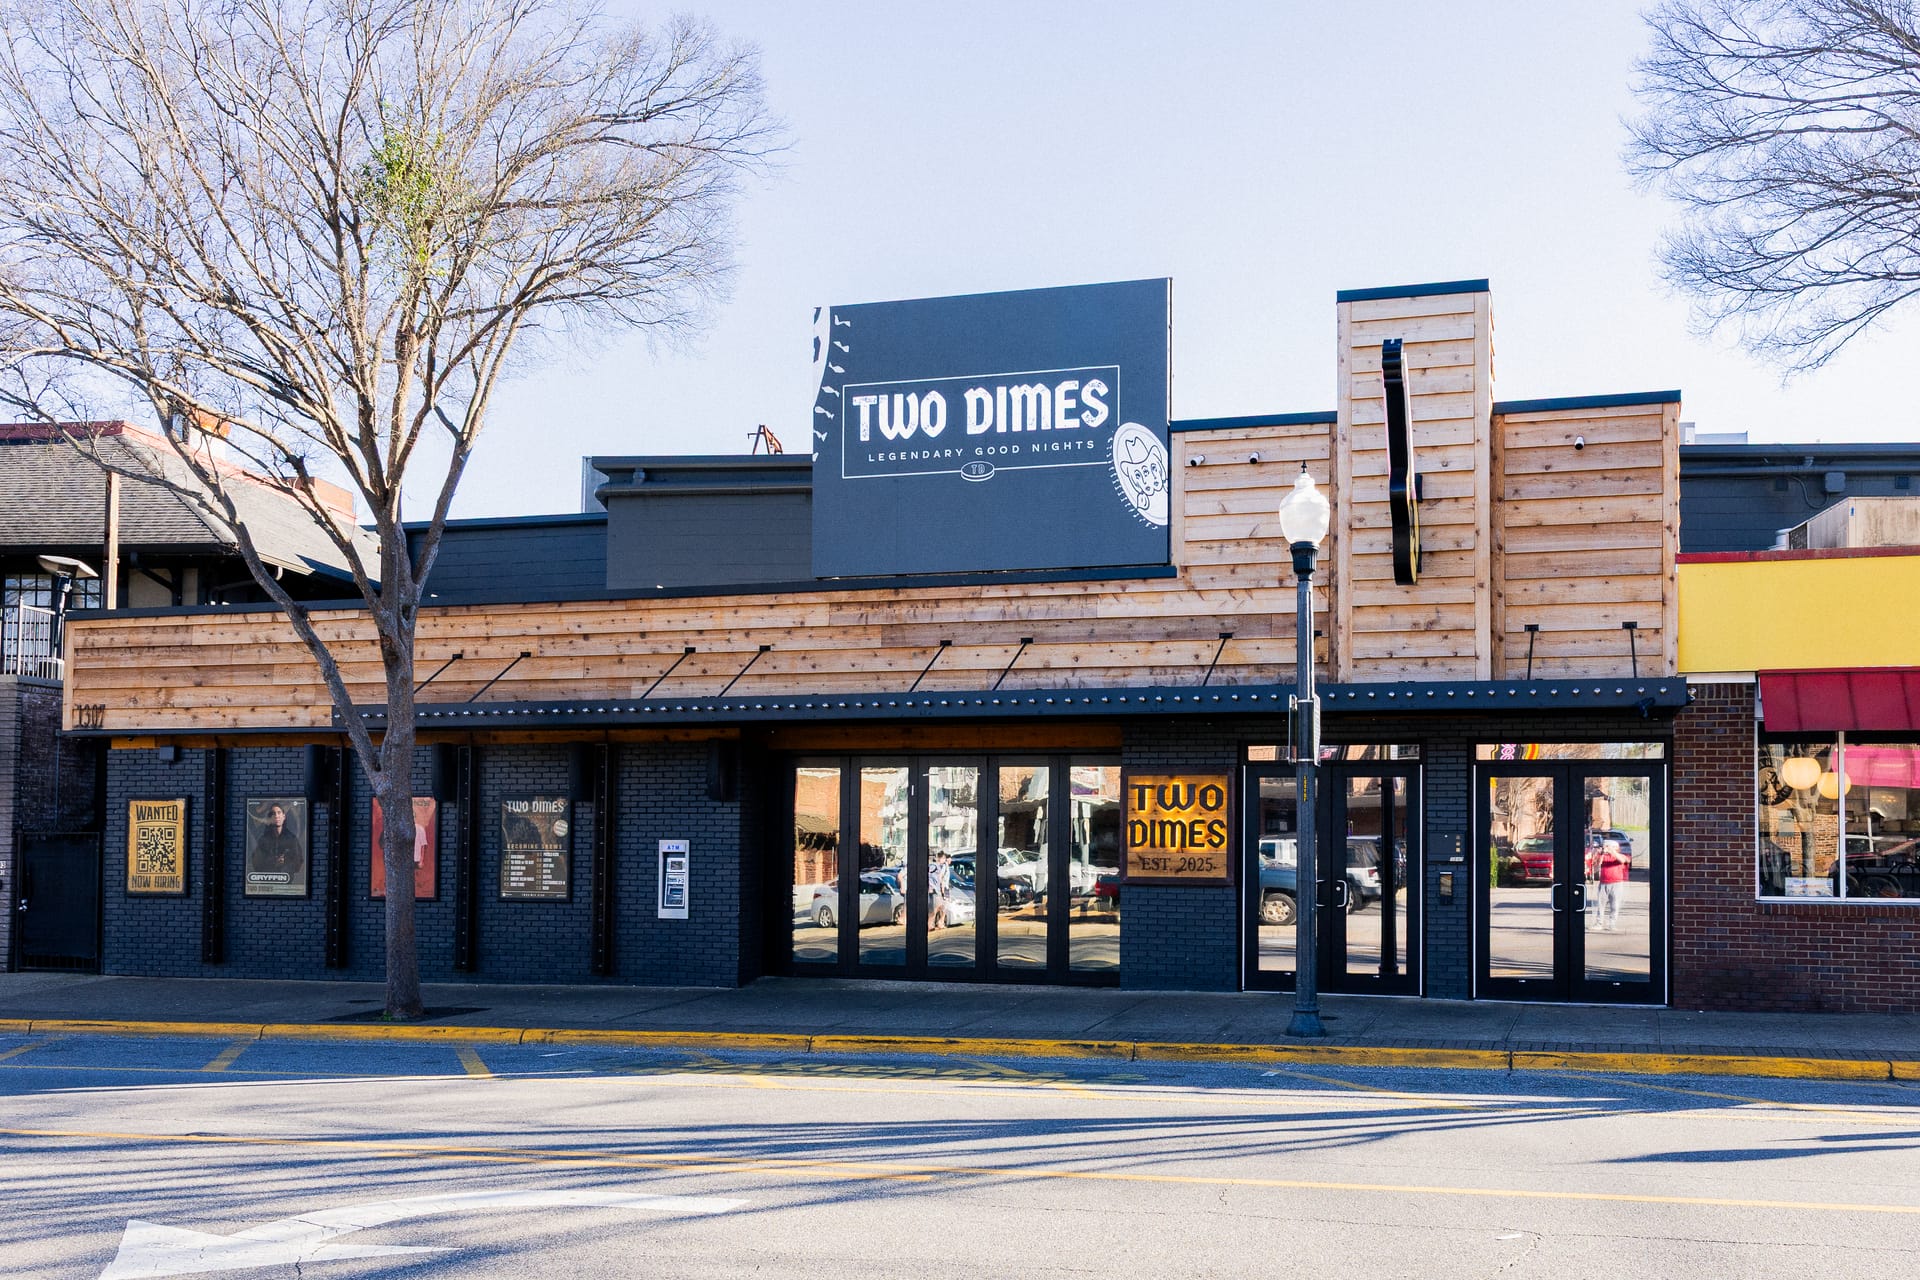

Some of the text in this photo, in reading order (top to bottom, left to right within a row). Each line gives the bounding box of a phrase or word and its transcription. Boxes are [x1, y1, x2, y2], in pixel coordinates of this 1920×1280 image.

[852, 378, 1110, 442] TWO DIMES
[868, 440, 1095, 462] LEGENDARY GOOD NIGHTS
[506, 800, 565, 813] TWO DIMES
[1130, 784, 1224, 811] TWO
[136, 805, 178, 821] WANTED
[1128, 819, 1226, 849] DIMES
[1180, 857, 1213, 872] 2025
[132, 875, 180, 889] NOW HIRING
